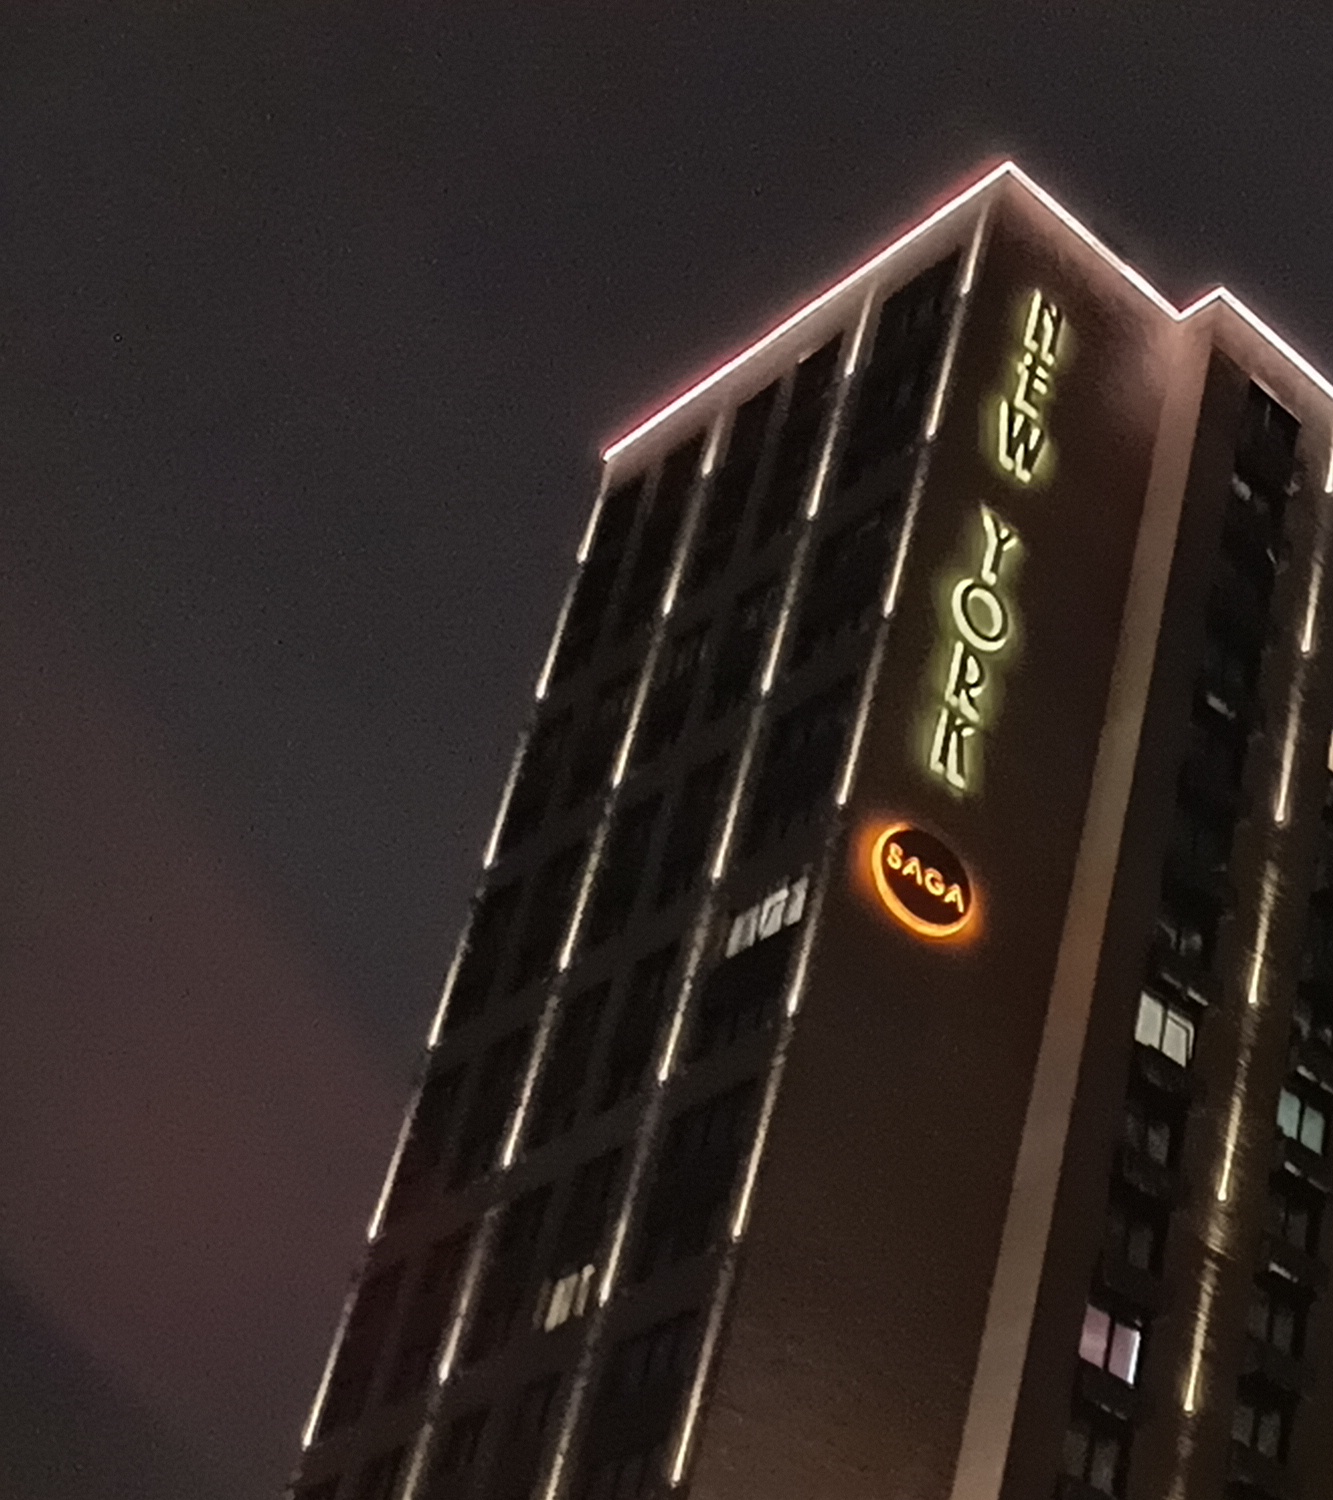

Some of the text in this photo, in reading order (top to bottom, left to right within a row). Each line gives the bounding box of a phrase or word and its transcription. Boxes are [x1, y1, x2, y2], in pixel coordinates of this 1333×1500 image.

[930, 288, 1065, 790] NEW YORK
[887, 842, 965, 914] SAGA
